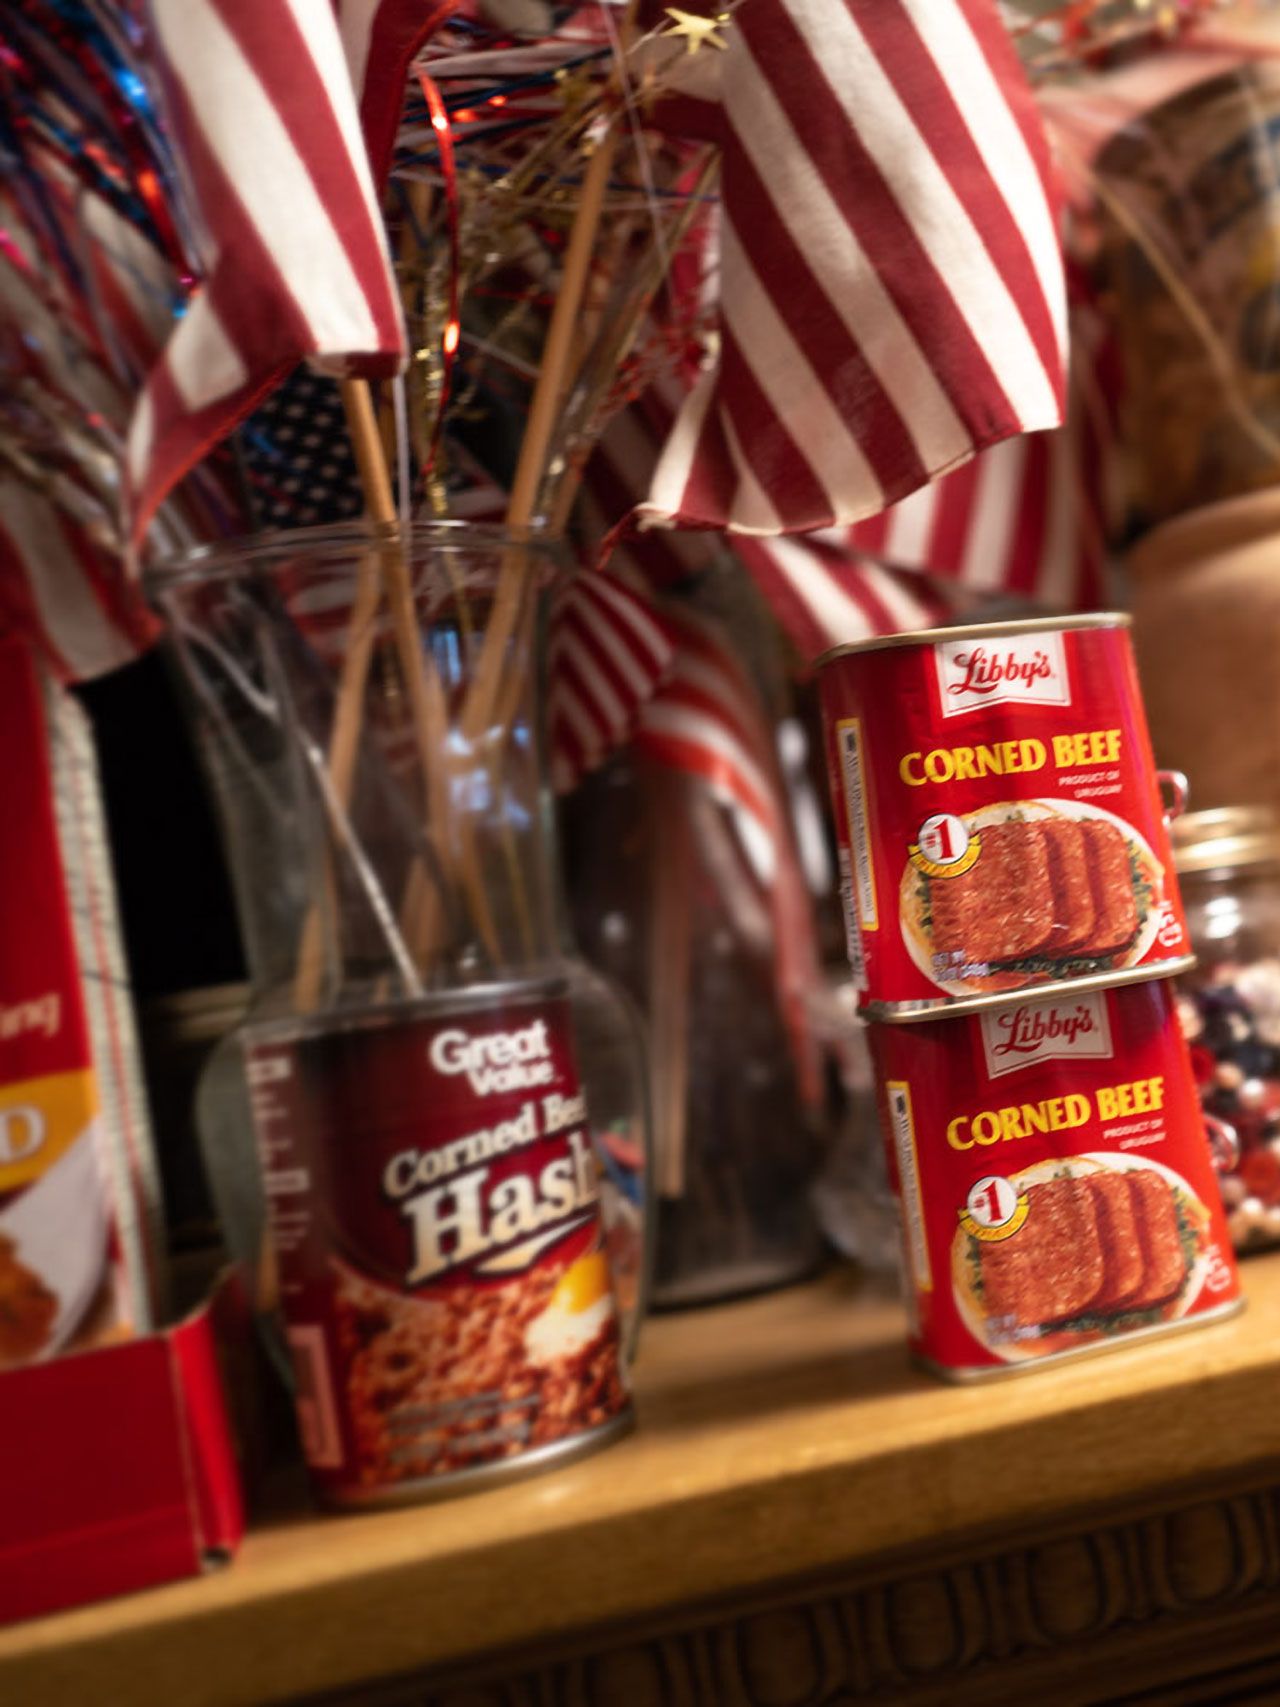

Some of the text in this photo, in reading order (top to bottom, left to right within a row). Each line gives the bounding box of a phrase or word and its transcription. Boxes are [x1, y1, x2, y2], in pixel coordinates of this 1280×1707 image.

[946, 647, 1052, 695] Libby's
[900, 729, 1123, 787] CORNED BEEF
[429, 1018, 552, 1075] Great
[991, 1005, 1095, 1056] Libby's
[466, 1060, 556, 1096] Value
[947, 1076, 1165, 1151] CORNED BEEF
[383, 1101, 540, 1197] Corned
